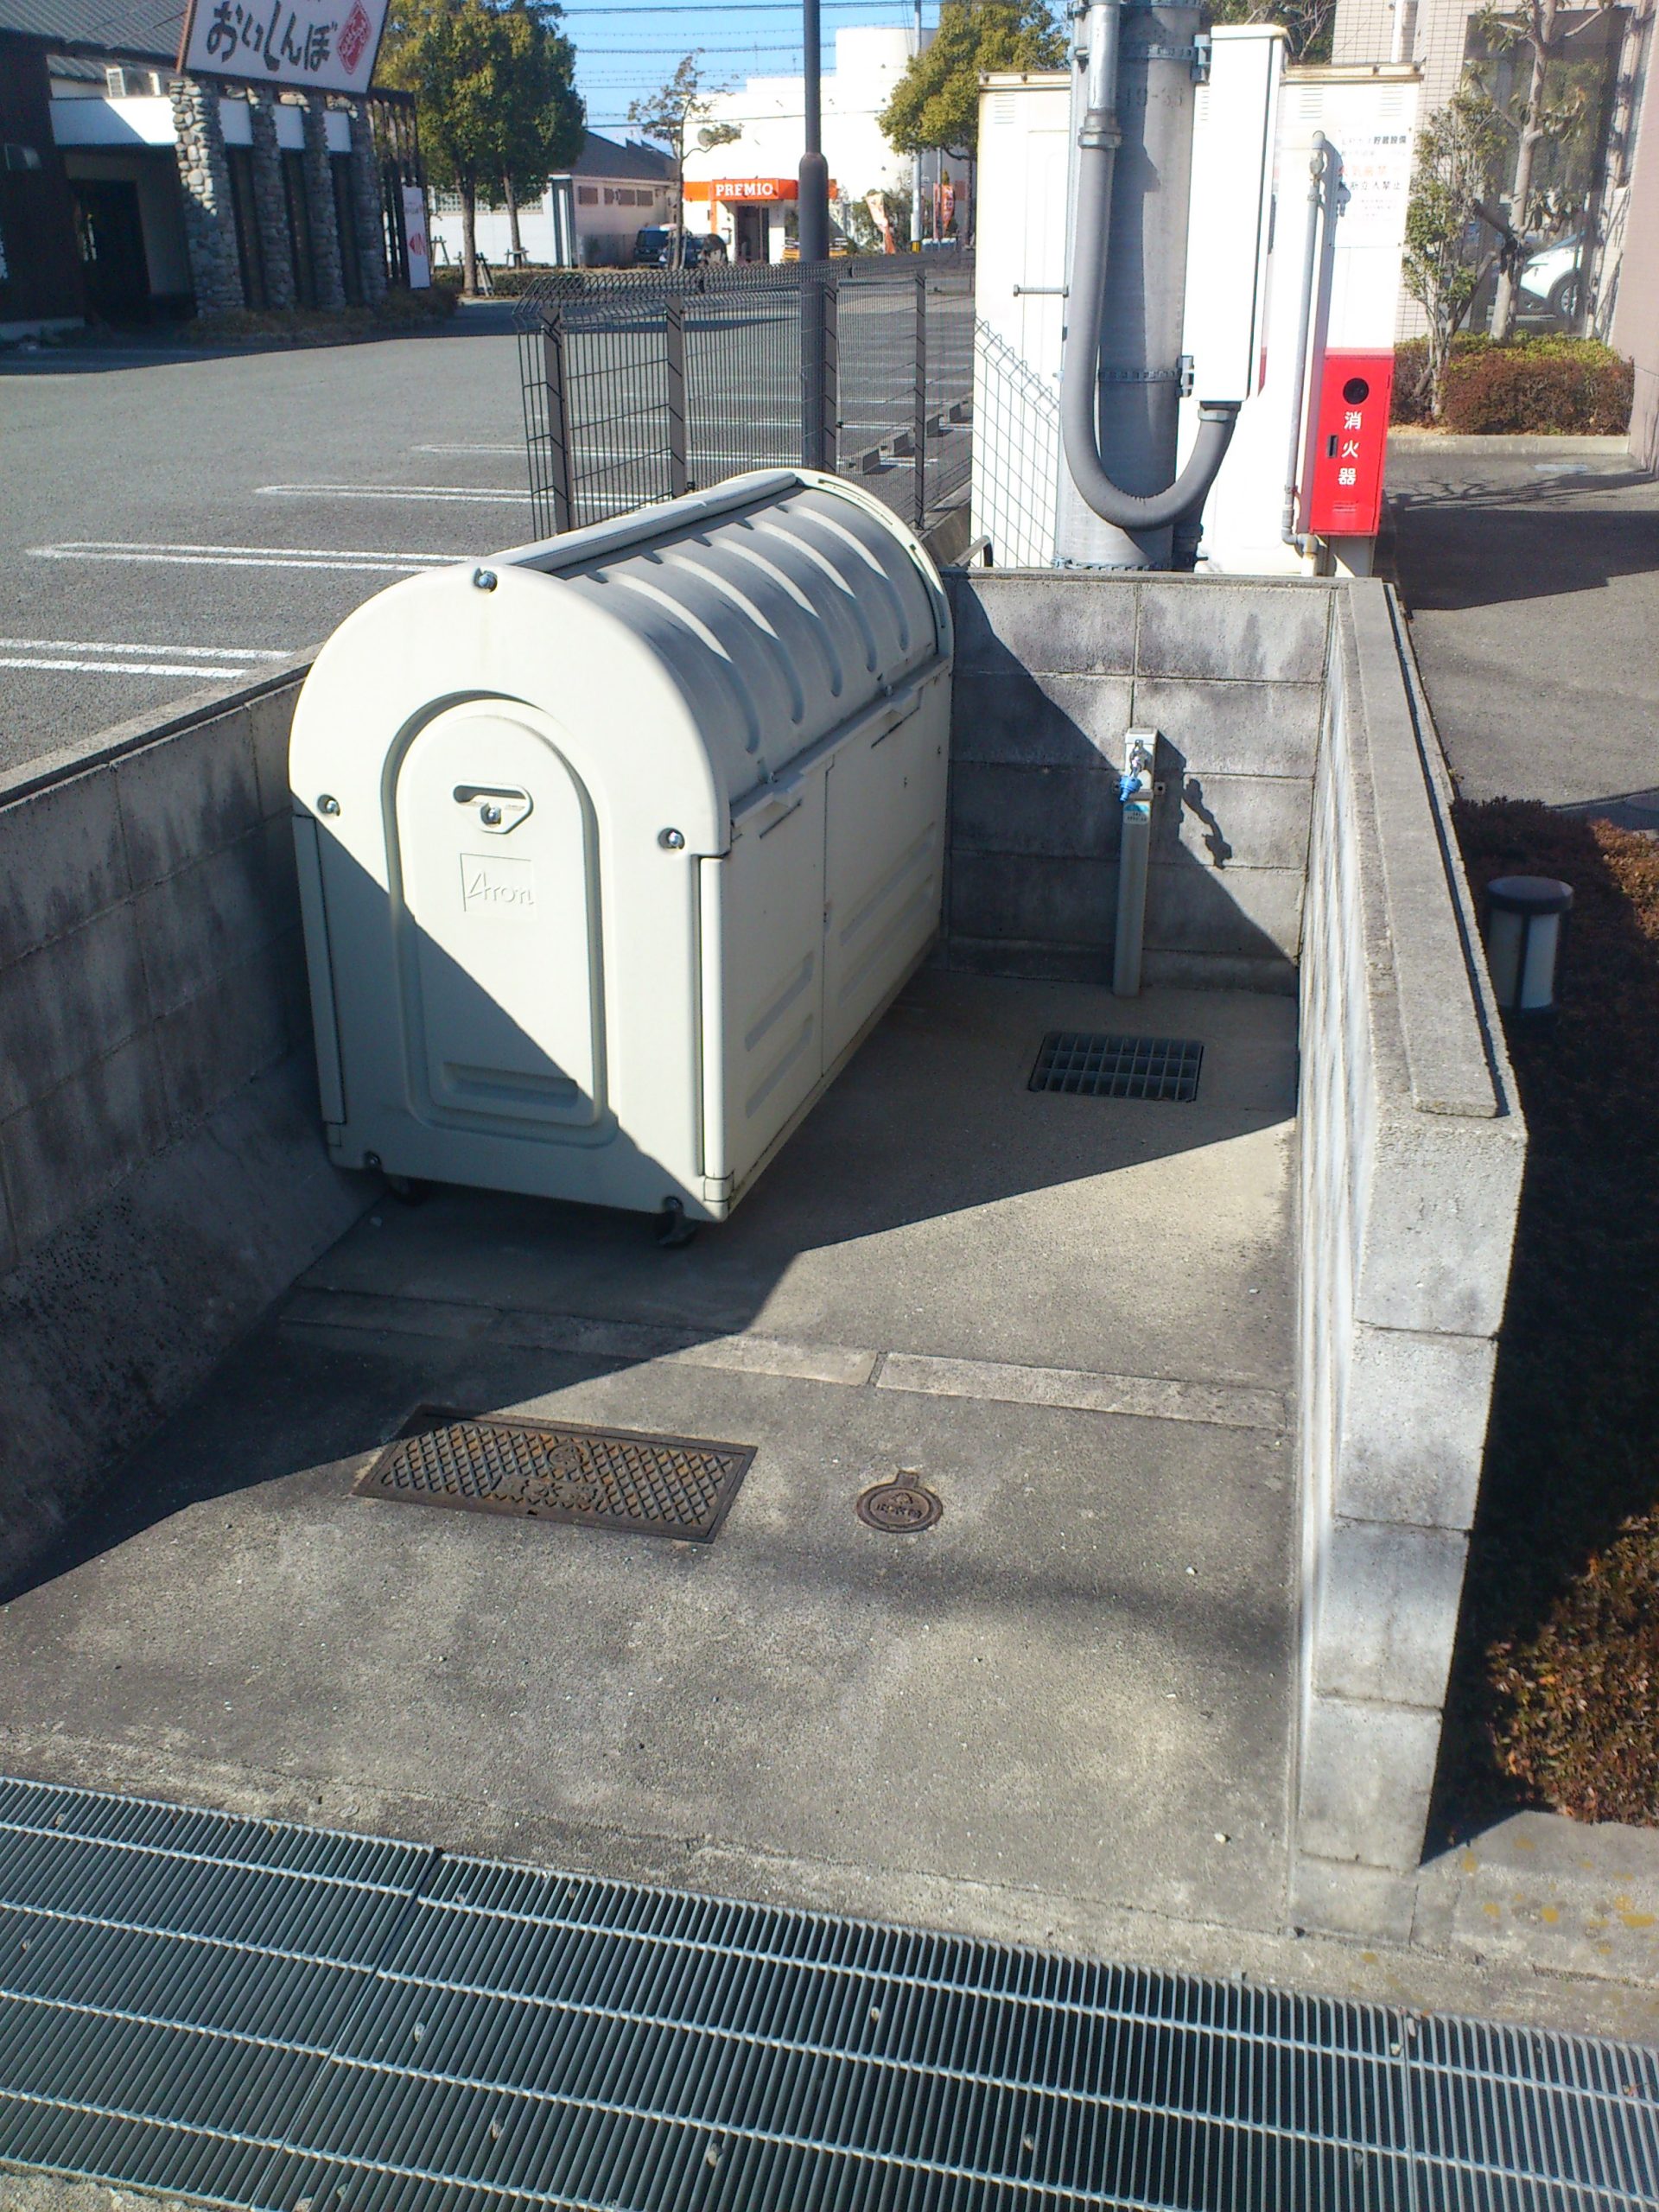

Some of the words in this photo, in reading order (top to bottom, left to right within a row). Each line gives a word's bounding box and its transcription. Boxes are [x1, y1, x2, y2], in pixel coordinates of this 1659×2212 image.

[207, 0, 338, 73] おいしんぼ
[715, 182, 774, 197] PREMIO
[1338, 411, 1362, 486] 消火器
[467, 872, 535, 905] Aron
